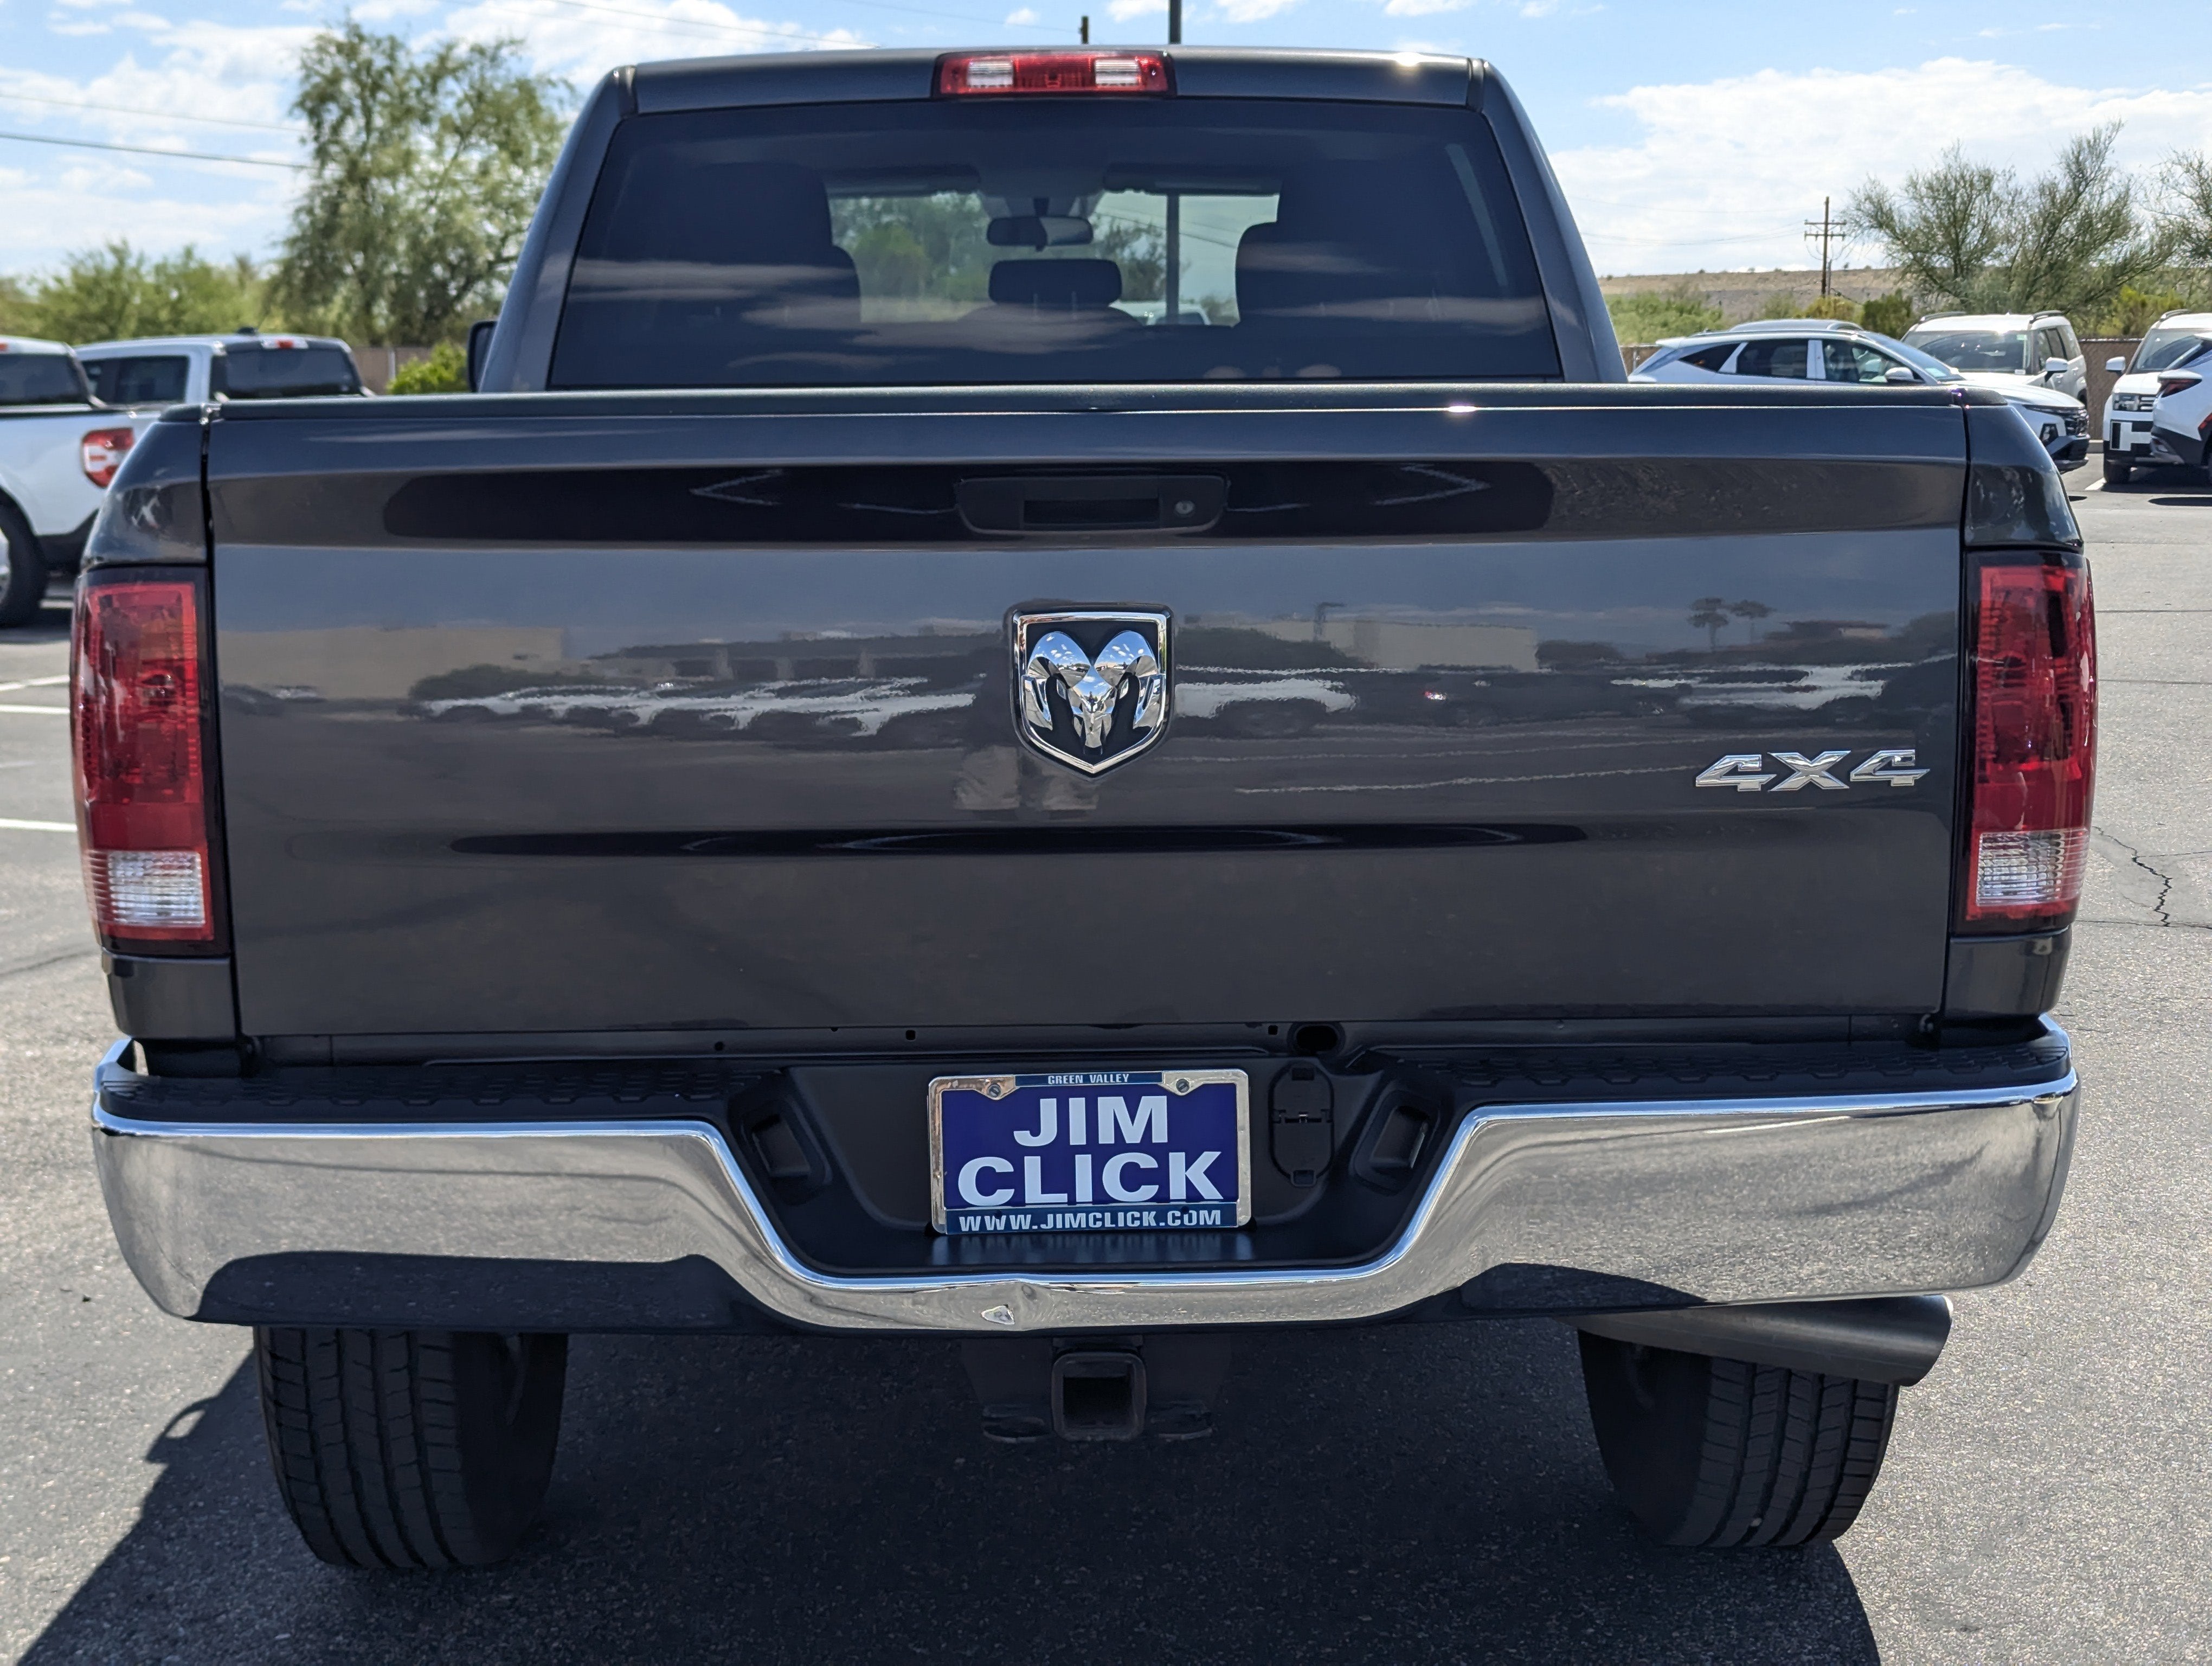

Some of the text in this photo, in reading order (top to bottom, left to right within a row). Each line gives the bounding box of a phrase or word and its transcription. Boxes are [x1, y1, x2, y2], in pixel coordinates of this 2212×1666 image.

[1695, 749, 1930, 792] 4X4
[1047, 1073, 1129, 1085] GREEN VALLEY
[1013, 1095, 1168, 1146] JIM
[958, 1151, 1224, 1206] CLICK
[959, 1210, 1221, 1232] WWW.JIMCLICK.COM
